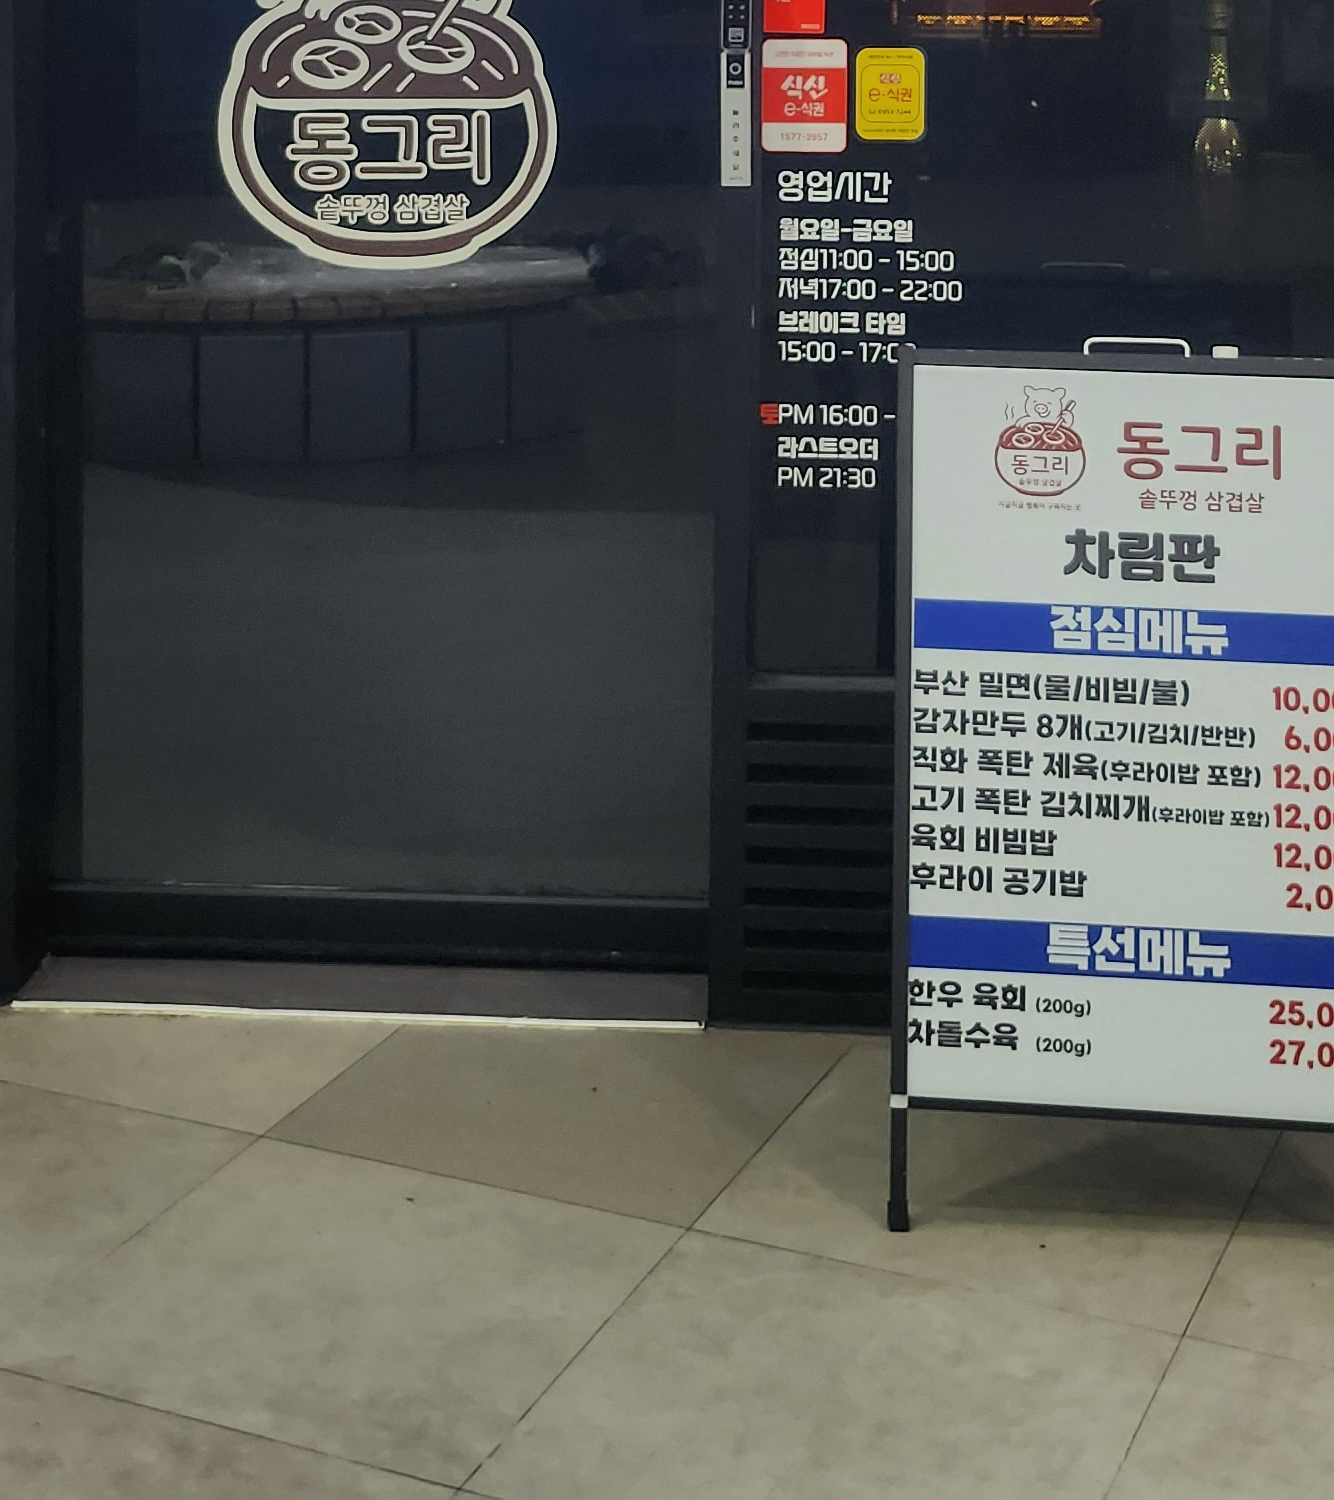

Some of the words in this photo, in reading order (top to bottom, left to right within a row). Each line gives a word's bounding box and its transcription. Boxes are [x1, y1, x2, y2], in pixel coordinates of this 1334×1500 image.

[781, 74, 829, 101] 식신
[285, 110, 493, 192] 동그리
[780, 132, 829, 142] 1577-3957
[777, 169, 894, 204] 영업시간
[315, 194, 390, 223] 솥뚜껑
[393, 194, 471, 223] 삼겹살
[779, 217, 915, 243] 월요일-금요일
[896, 250, 955, 272] 15:00
[899, 279, 964, 302] 22:00
[777, 310, 861, 334] 브레이크
[865, 311, 907, 336] 타임
[777, 341, 836, 363] 15:00
[858, 341, 916, 364] 17:0
[778, 403, 814, 426] PM
[819, 404, 878, 427] 16:00
[777, 436, 880, 461] 라스트오더
[1010, 453, 1070, 476] 동그리
[1116, 420, 1283, 481] 동그리
[777, 466, 814, 489] PM
[819, 467, 877, 489] 21:30
[1138, 488, 1198, 512] 솥뚜껑
[1204, 491, 1265, 514] 삼겹살
[1063, 528, 1221, 584] 차림판
[1050, 604, 1230, 656] 점심메뉴
[913, 669, 970, 698] 부산
[979, 671, 1190, 707] 밀면(물/비빔/불)
[913, 708, 1027, 738] 감자만두
[1036, 714, 1256, 749] 8개(고기/김치/반반)
[912, 746, 968, 774] 직화
[977, 748, 1033, 777] 폭탄
[1043, 751, 1200, 786] 제육(후라이밥
[1207, 764, 1262, 789] 포함)
[911, 785, 964, 814] 고기
[974, 787, 1031, 817] 폭탄
[1229, 809, 1270, 828] 포함)
[910, 823, 965, 853] 육회
[975, 826, 1058, 857] 비빔밥
[909, 862, 993, 894] 후라이
[1003, 866, 1087, 898] 공기밥
[1046, 922, 1231, 978] 특선메뉴
[908, 979, 963, 1007] 한우
[972, 983, 1027, 1012] 육회
[1035, 998, 1091, 1018] (200g)
[907, 1018, 1019, 1050] 차돌수육
[1035, 1037, 1091, 1057] (200g)
